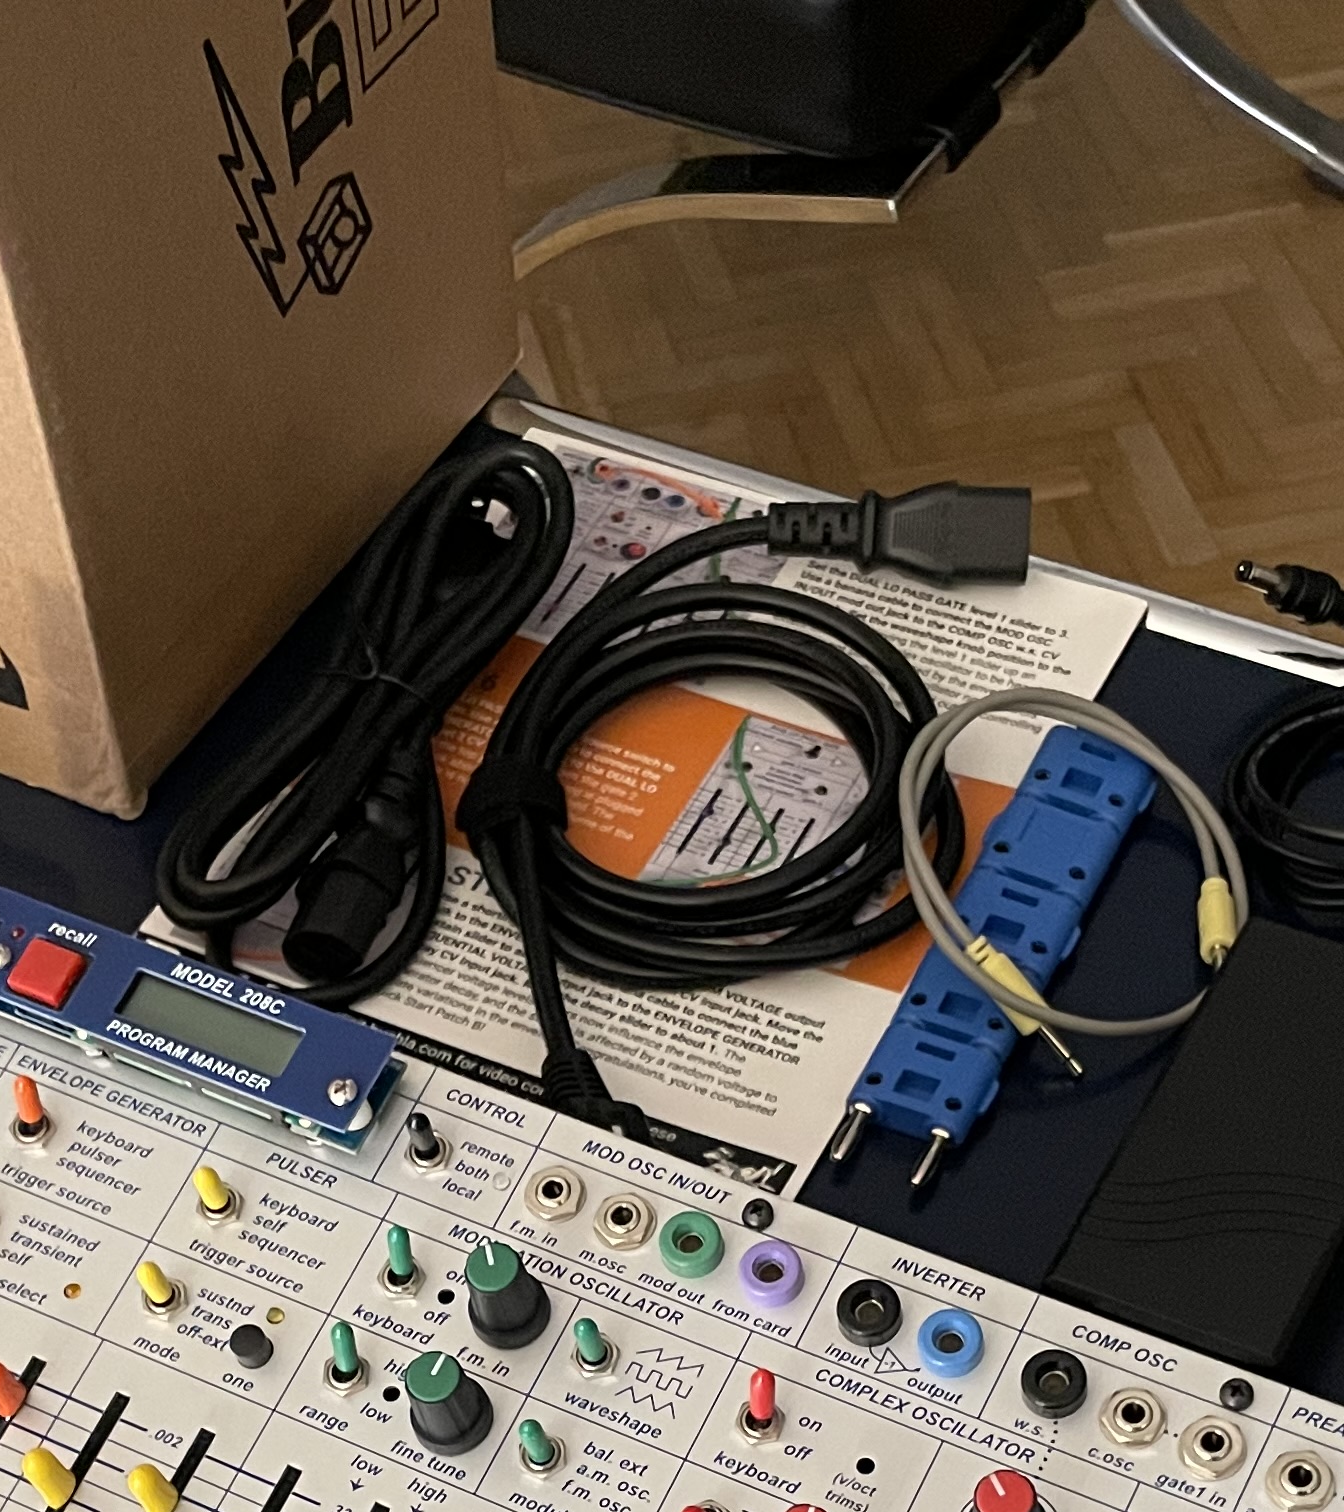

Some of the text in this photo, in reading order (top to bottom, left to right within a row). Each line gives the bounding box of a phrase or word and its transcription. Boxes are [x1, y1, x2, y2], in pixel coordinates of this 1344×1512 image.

[47, 921, 98, 948] recall
[170, 962, 286, 1015] MODEL 208C
[106, 1019, 271, 1092] PROGRAM MANAGER
[722, 1034, 801, 1066] GENERATOR
[18, 1055, 207, 1138] ENVELOPE GENERATOR
[446, 1088, 527, 1128] CONTROL
[76, 1120, 154, 1159] keyboard
[459, 1140, 515, 1168] remote
[265, 1152, 339, 1189] PULSER
[441, 1177, 483, 1201] local
[454, 1159, 490, 1182] both
[581, 1140, 733, 1207] MOD OSC IN/OUT
[10, 1230, 84, 1269] transient
[18, 1213, 101, 1253] sustained
[448, 1224, 684, 1322] MODATION OSCILLATOR
[577, 1248, 628, 1275] m.osc
[892, 1256, 987, 1302] INVERTER
[637, 1272, 706, 1305] mod out
[353, 1304, 435, 1347] keyboard
[711, 1300, 792, 1338] from card
[824, 1343, 870, 1369] input
[1071, 1324, 1178, 1374] COMP OSC
[906, 1375, 964, 1405] output
[298, 1402, 349, 1433] range
[814, 1368, 1037, 1464] COMPLEX OSCILLATOR
[390, 1441, 467, 1481] fine tune
[1155, 1471, 1228, 1507] gate1 in
